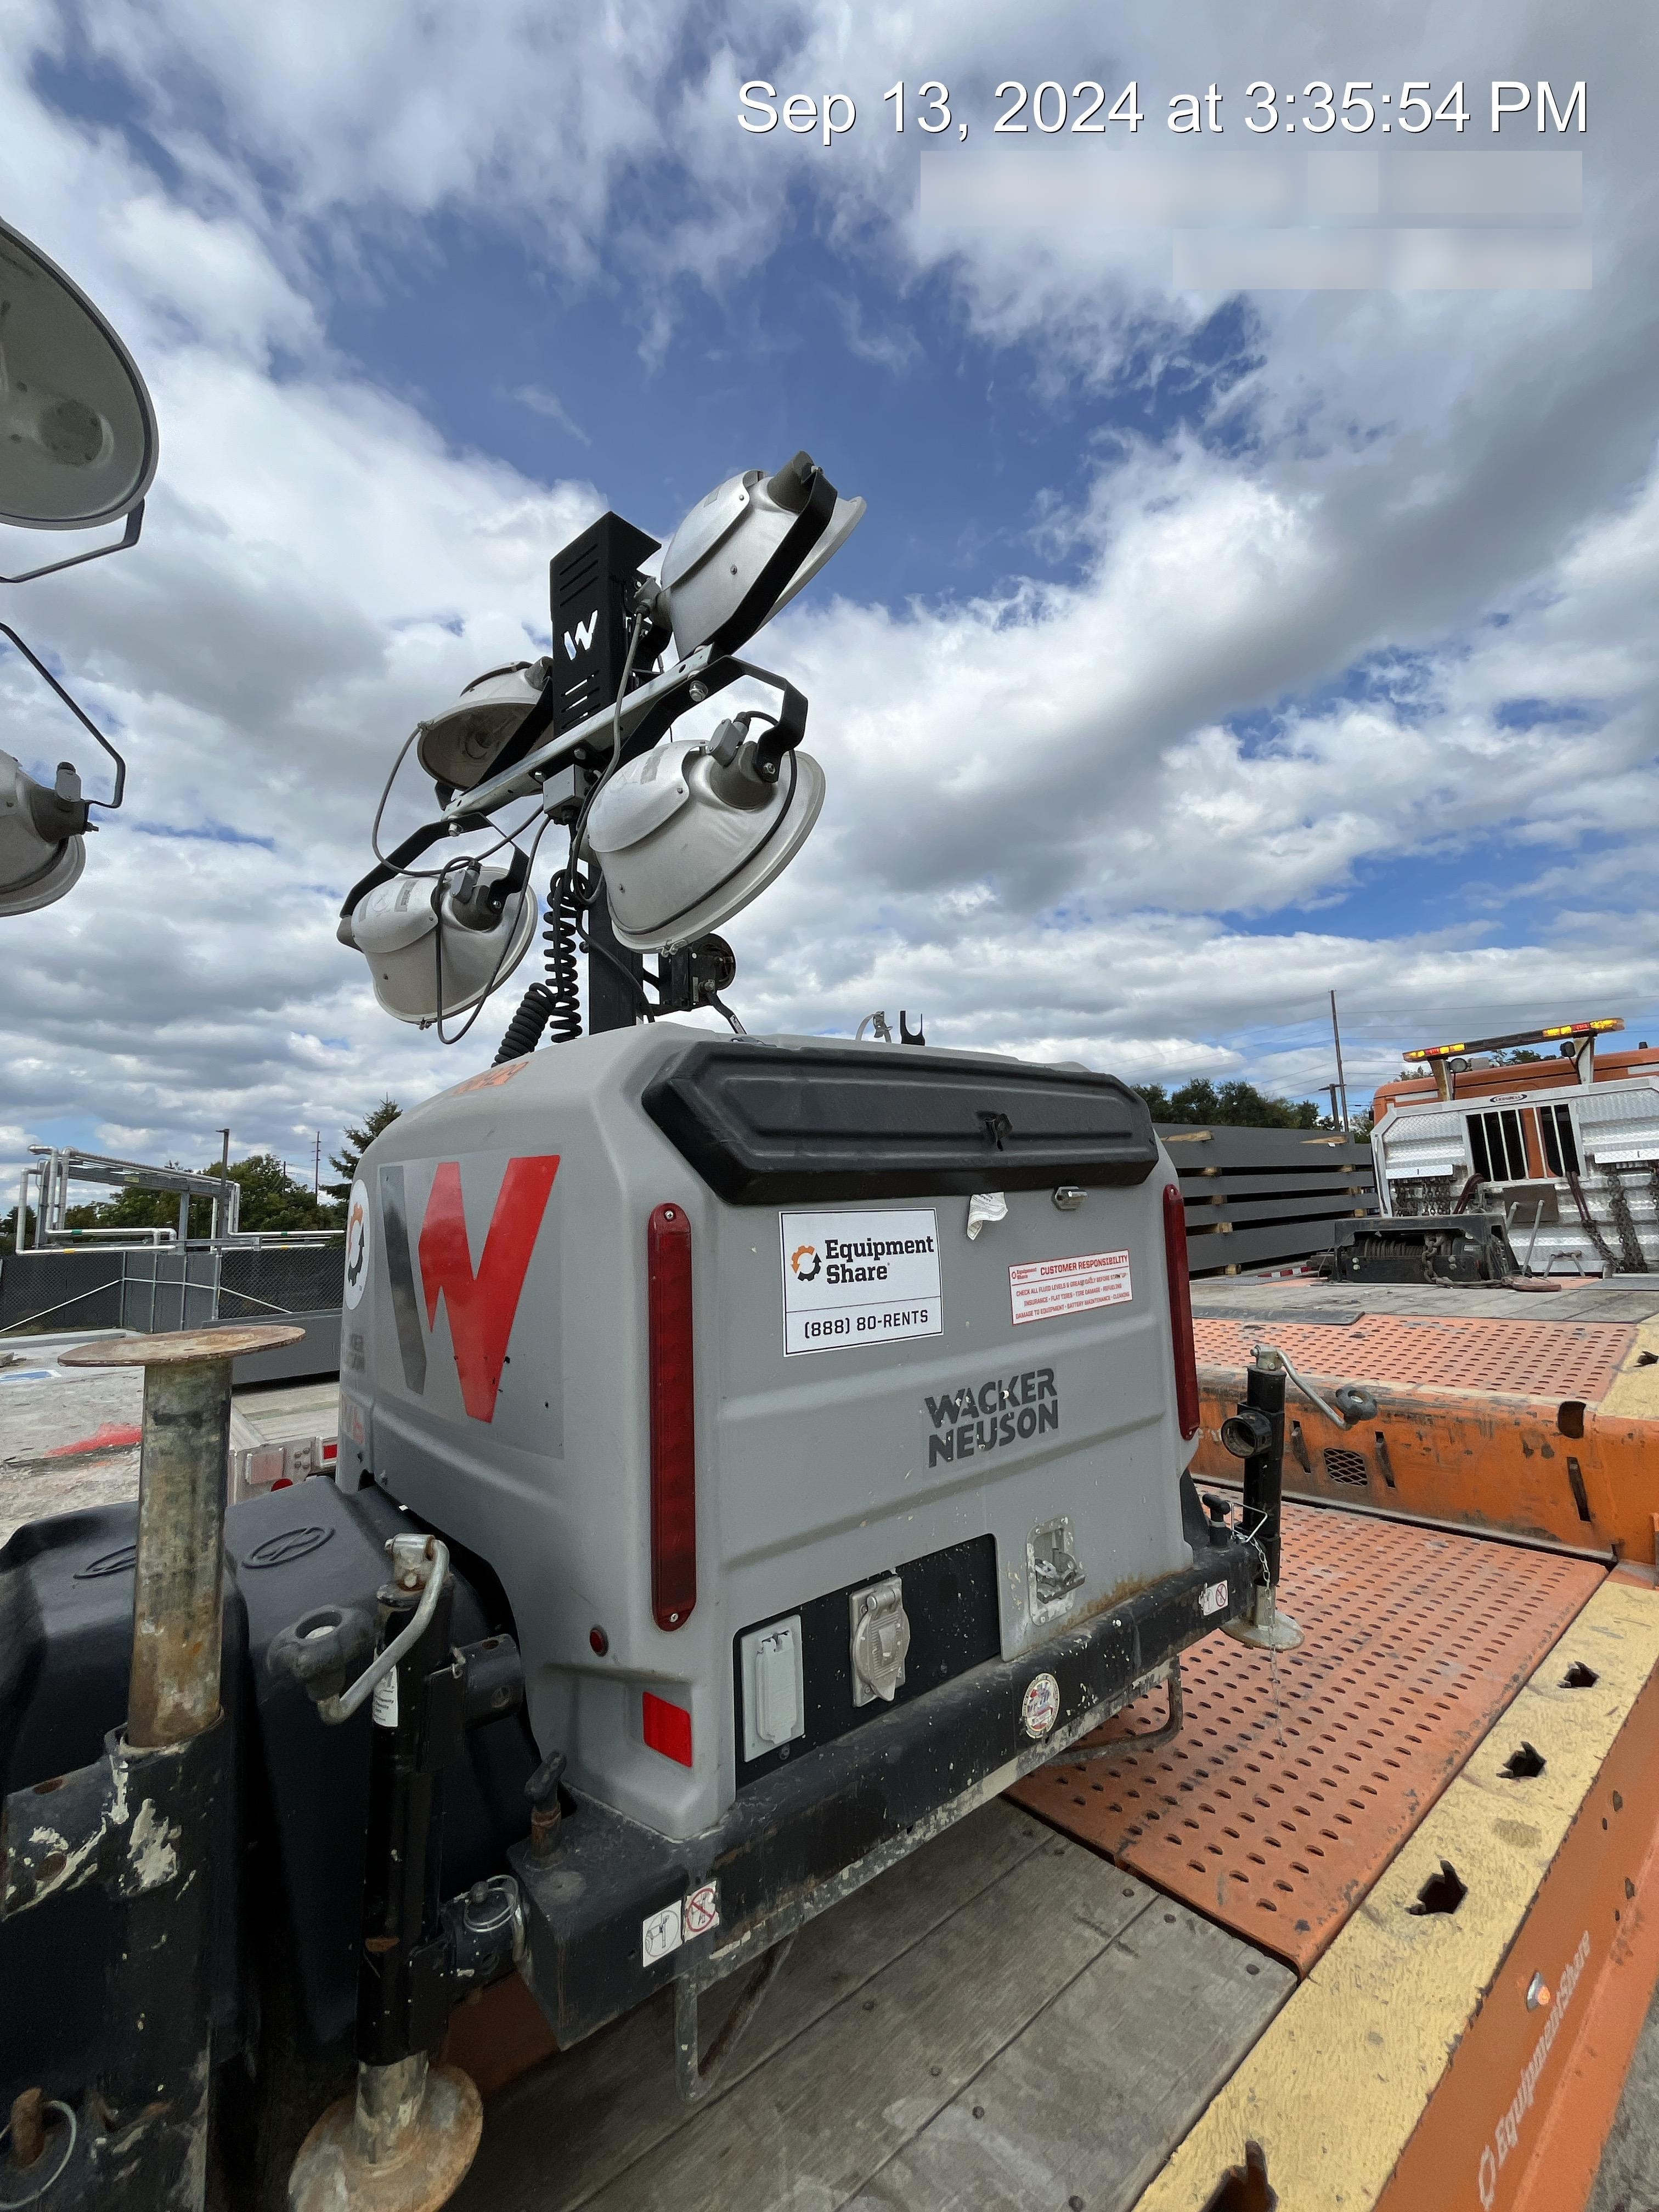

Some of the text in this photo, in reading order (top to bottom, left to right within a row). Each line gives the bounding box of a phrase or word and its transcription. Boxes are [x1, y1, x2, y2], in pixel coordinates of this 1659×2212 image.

[825, 1236, 935, 1263] Equipment
[826, 1263, 888, 1284] Share
[1040, 1254, 1128, 1276] CUSTOMER RESPONSIBILITY
[1015, 1310, 1034, 1319] DAMAGE
[1040, 1304, 1064, 1314] EQUIPMENT
[1067, 1300, 1084, 1309] BATTERY
[1084, 1295, 1111, 1305] MAINTENANCE
[1113, 1291, 1130, 1300] CLEANING
[1016, 1289, 1030, 1297] CHECK
[1024, 1296, 1048, 1307] INSURANCE
[1103, 1283, 1122, 1291] REFUELING
[804, 1310, 928, 1339] (888) 80-RENTS
[924, 1368, 1057, 1429] WACKER
[928, 1399, 1058, 1468] NEUSON
